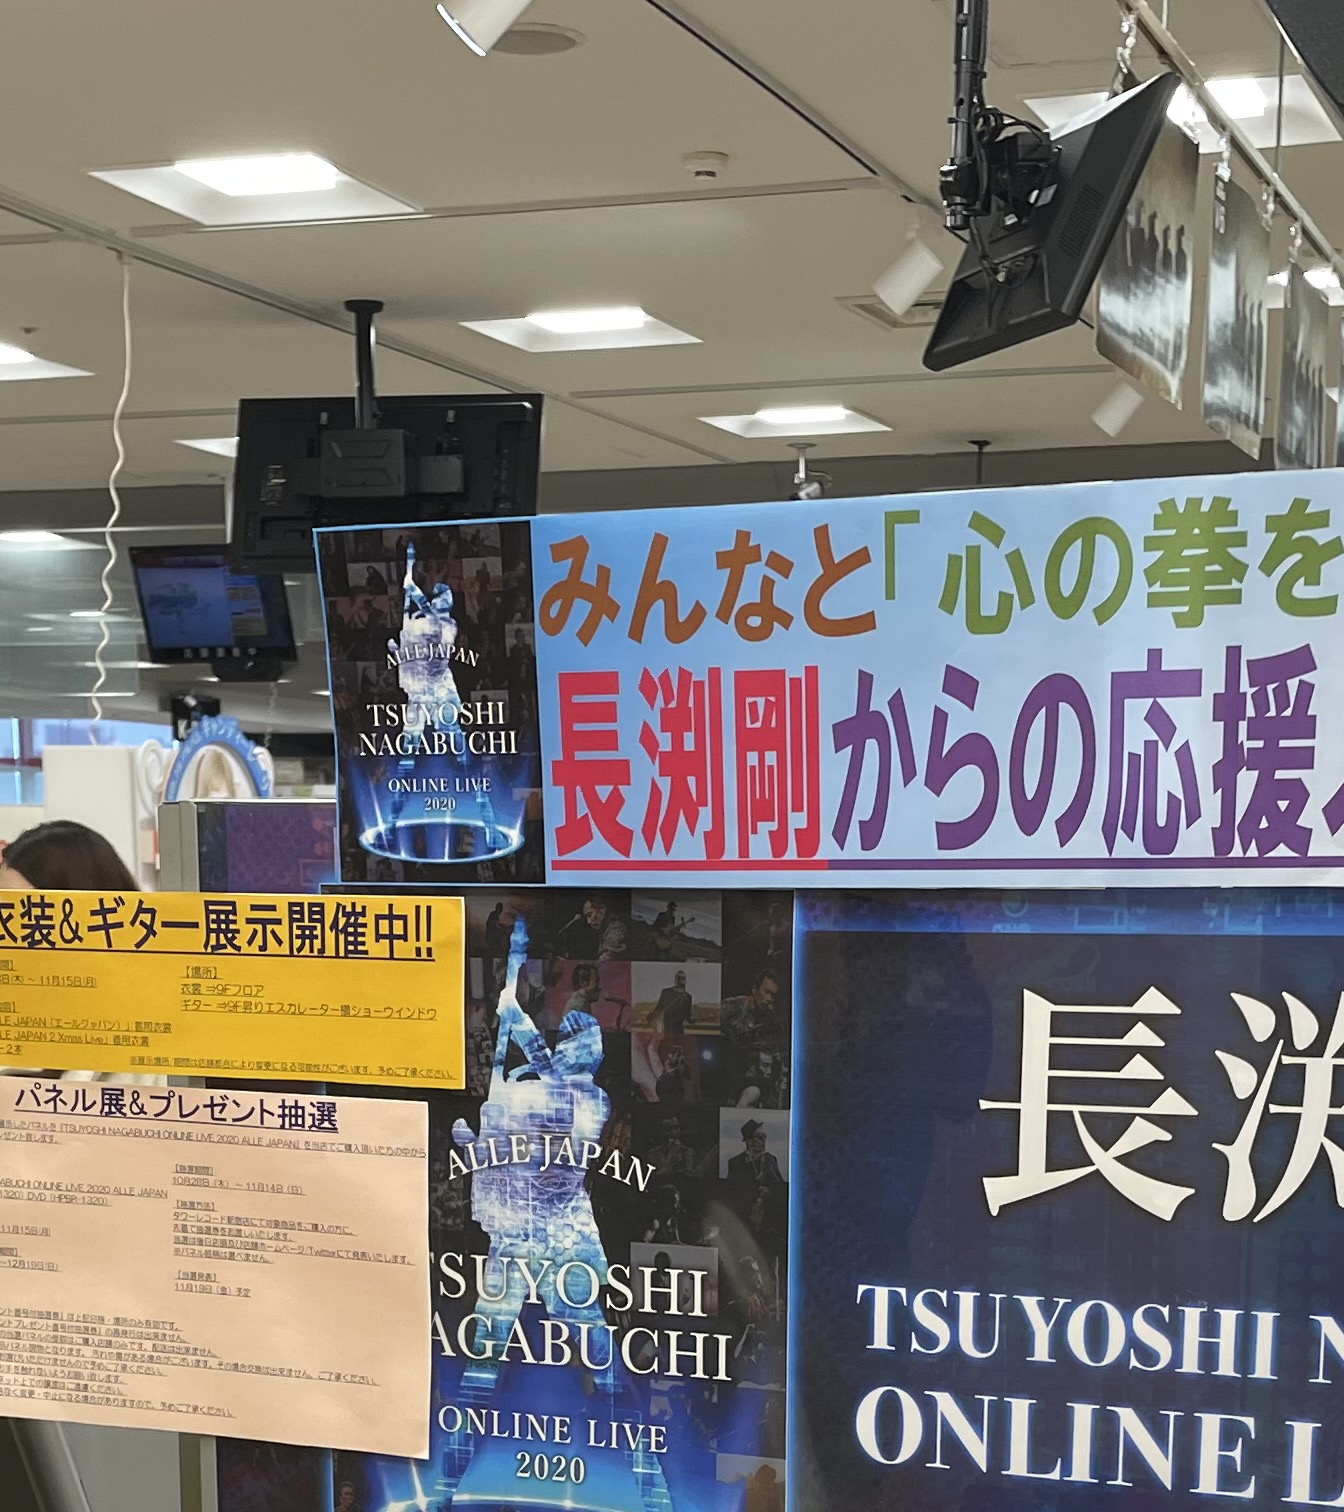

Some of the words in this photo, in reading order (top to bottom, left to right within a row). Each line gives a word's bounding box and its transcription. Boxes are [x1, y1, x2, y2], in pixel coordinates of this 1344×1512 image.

[387, 644, 425, 669] ALLE
[428, 643, 480, 667] JAPAN
[367, 702, 505, 727] TSUYOSHI
[359, 731, 517, 756] NAGABUCHI
[388, 778, 449, 792] ONLINE
[455, 778, 492, 792] LIVE
[424, 797, 456, 811] 2020
[14, 1083, 339, 1131] パネル展&プレゼント抽選
[447, 1133, 532, 1181] ALLE
[540, 1133, 656, 1193] JAPAN
[431, 1250, 708, 1317] SUYOSHI
[431, 1311, 733, 1381] AGABUCHI
[856, 1282, 1281, 1384] TSUYOSHI
[437, 1405, 573, 1444] ONLINE
[588, 1421, 669, 1454] LIVE
[853, 1384, 1257, 1500] ONLINE
[515, 1452, 586, 1484] 2020
